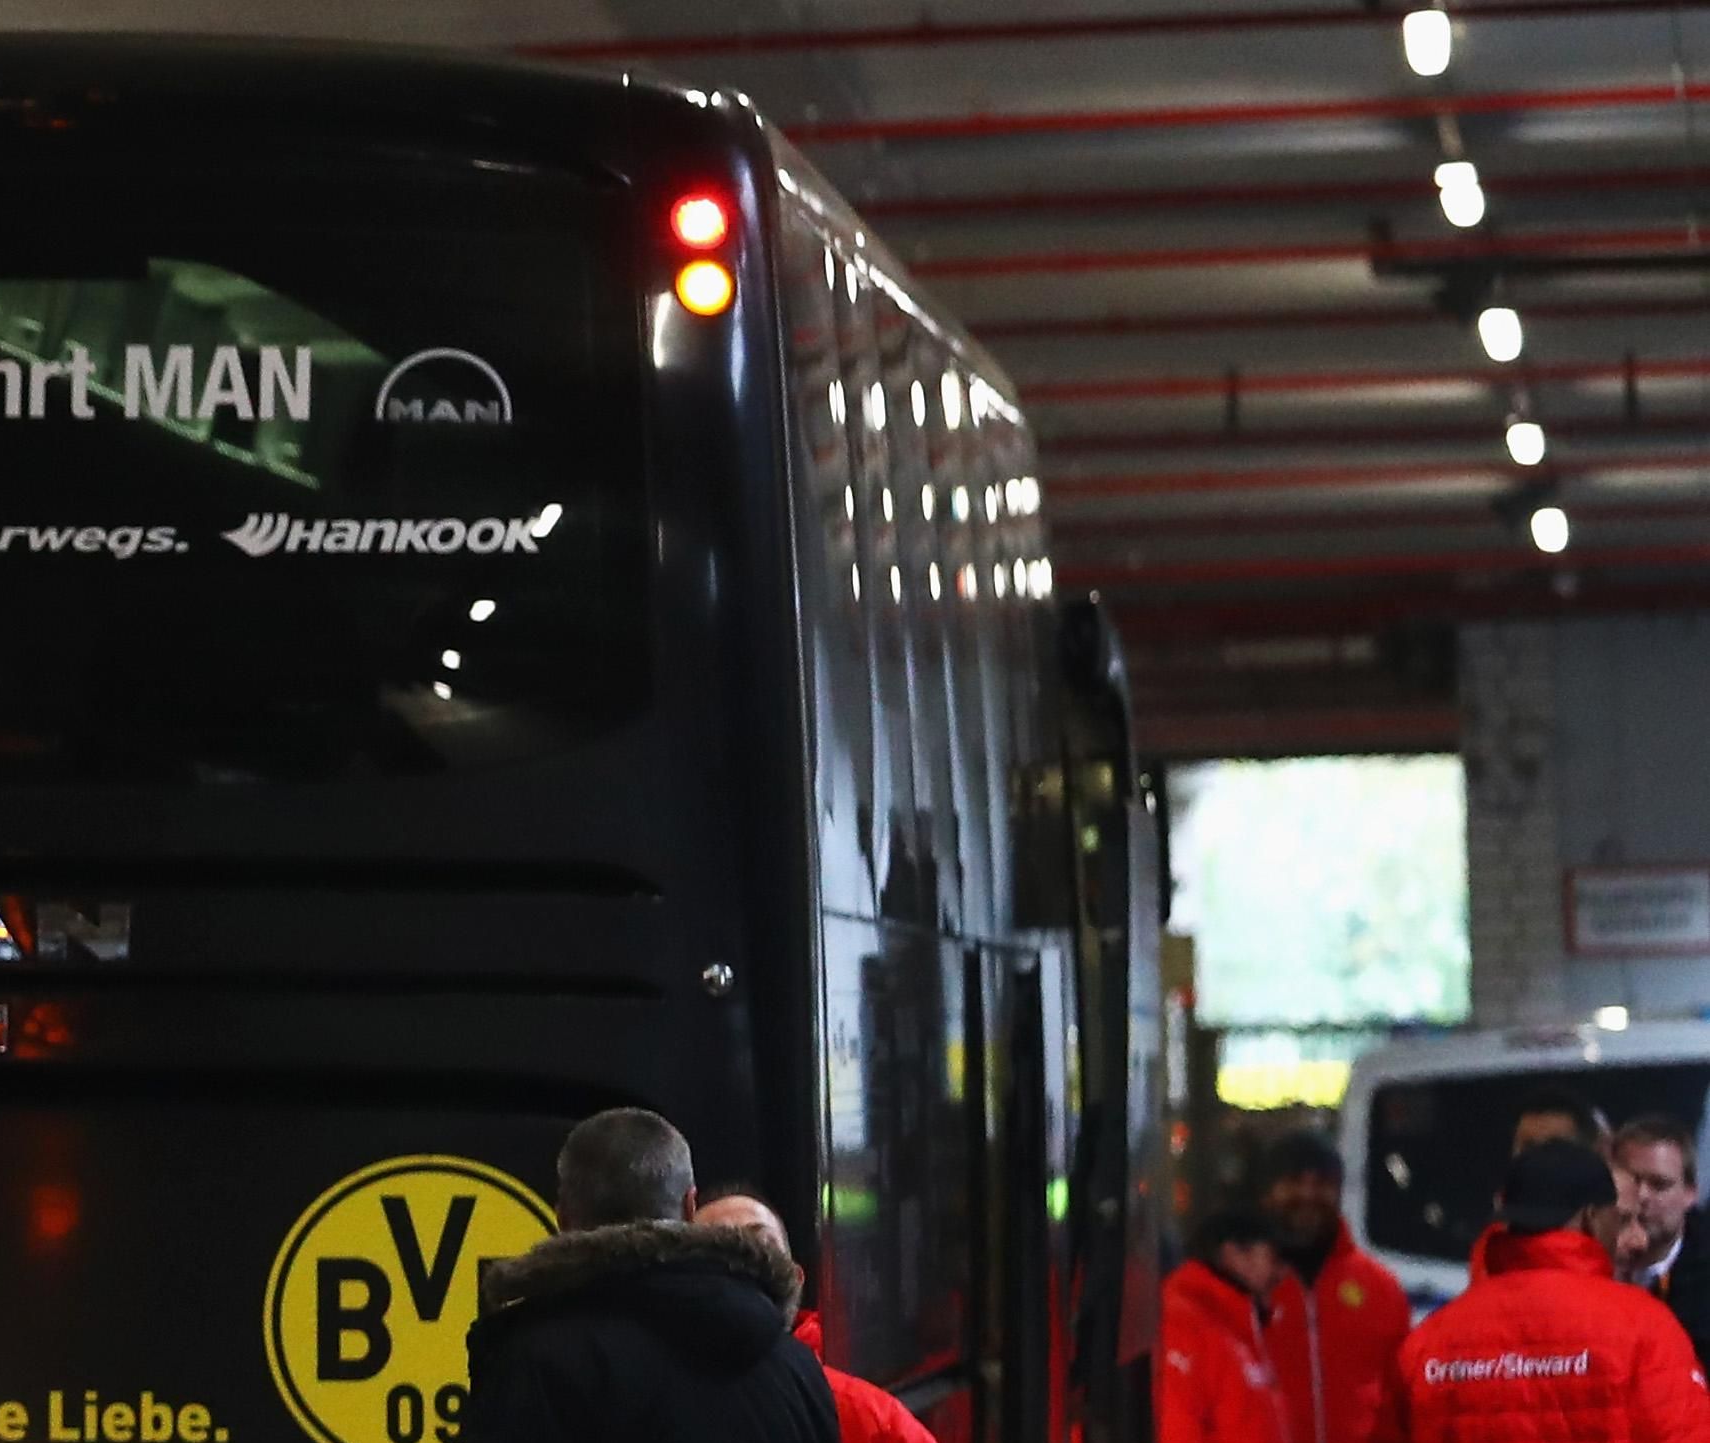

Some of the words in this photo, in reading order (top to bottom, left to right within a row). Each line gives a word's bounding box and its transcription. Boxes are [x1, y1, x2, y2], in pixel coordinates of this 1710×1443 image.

[124, 344, 312, 421] MAN
[386, 398, 499, 423] MAN
[316, 1195, 524, 1381] BV
[48, 1390, 230, 1443] Liebe.
